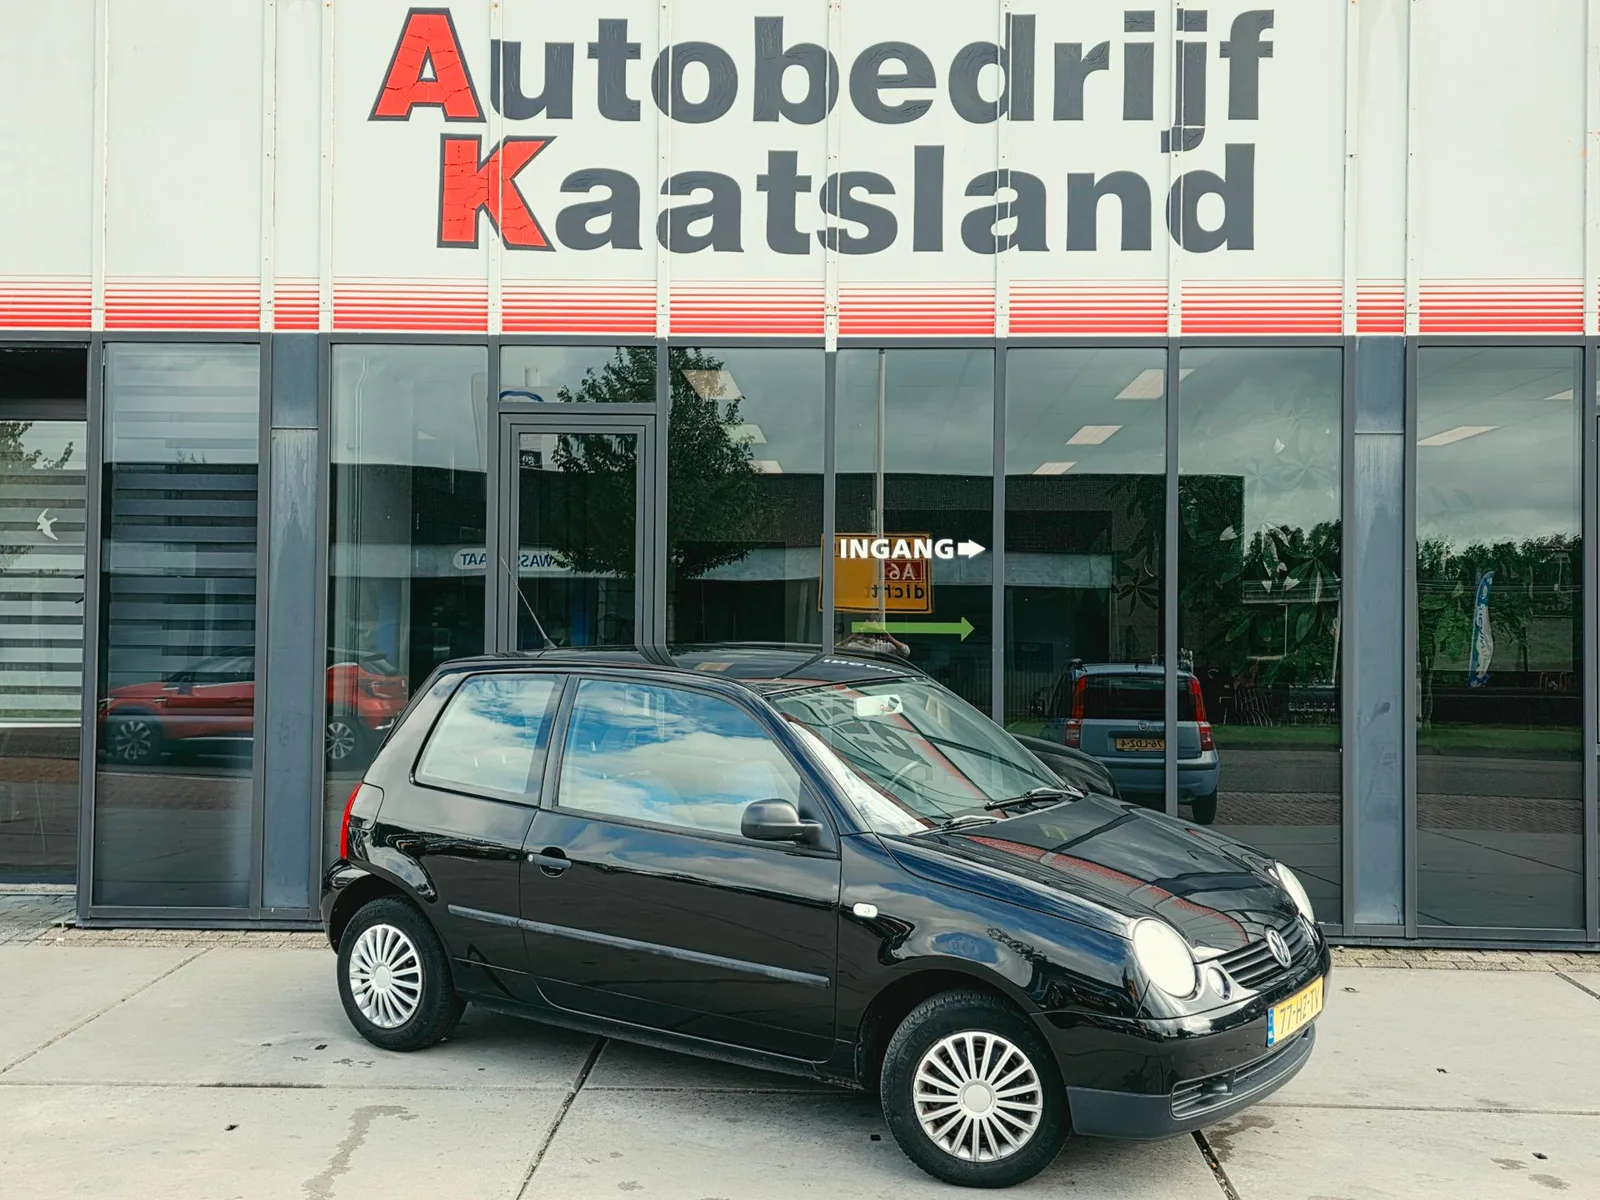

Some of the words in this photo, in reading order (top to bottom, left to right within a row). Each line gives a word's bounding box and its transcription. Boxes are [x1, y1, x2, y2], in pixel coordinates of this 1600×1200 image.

[367, 7, 1275, 153] Autobedrijf
[436, 133, 1256, 255] Kaatsland
[840, 538, 954, 559] INGANG
